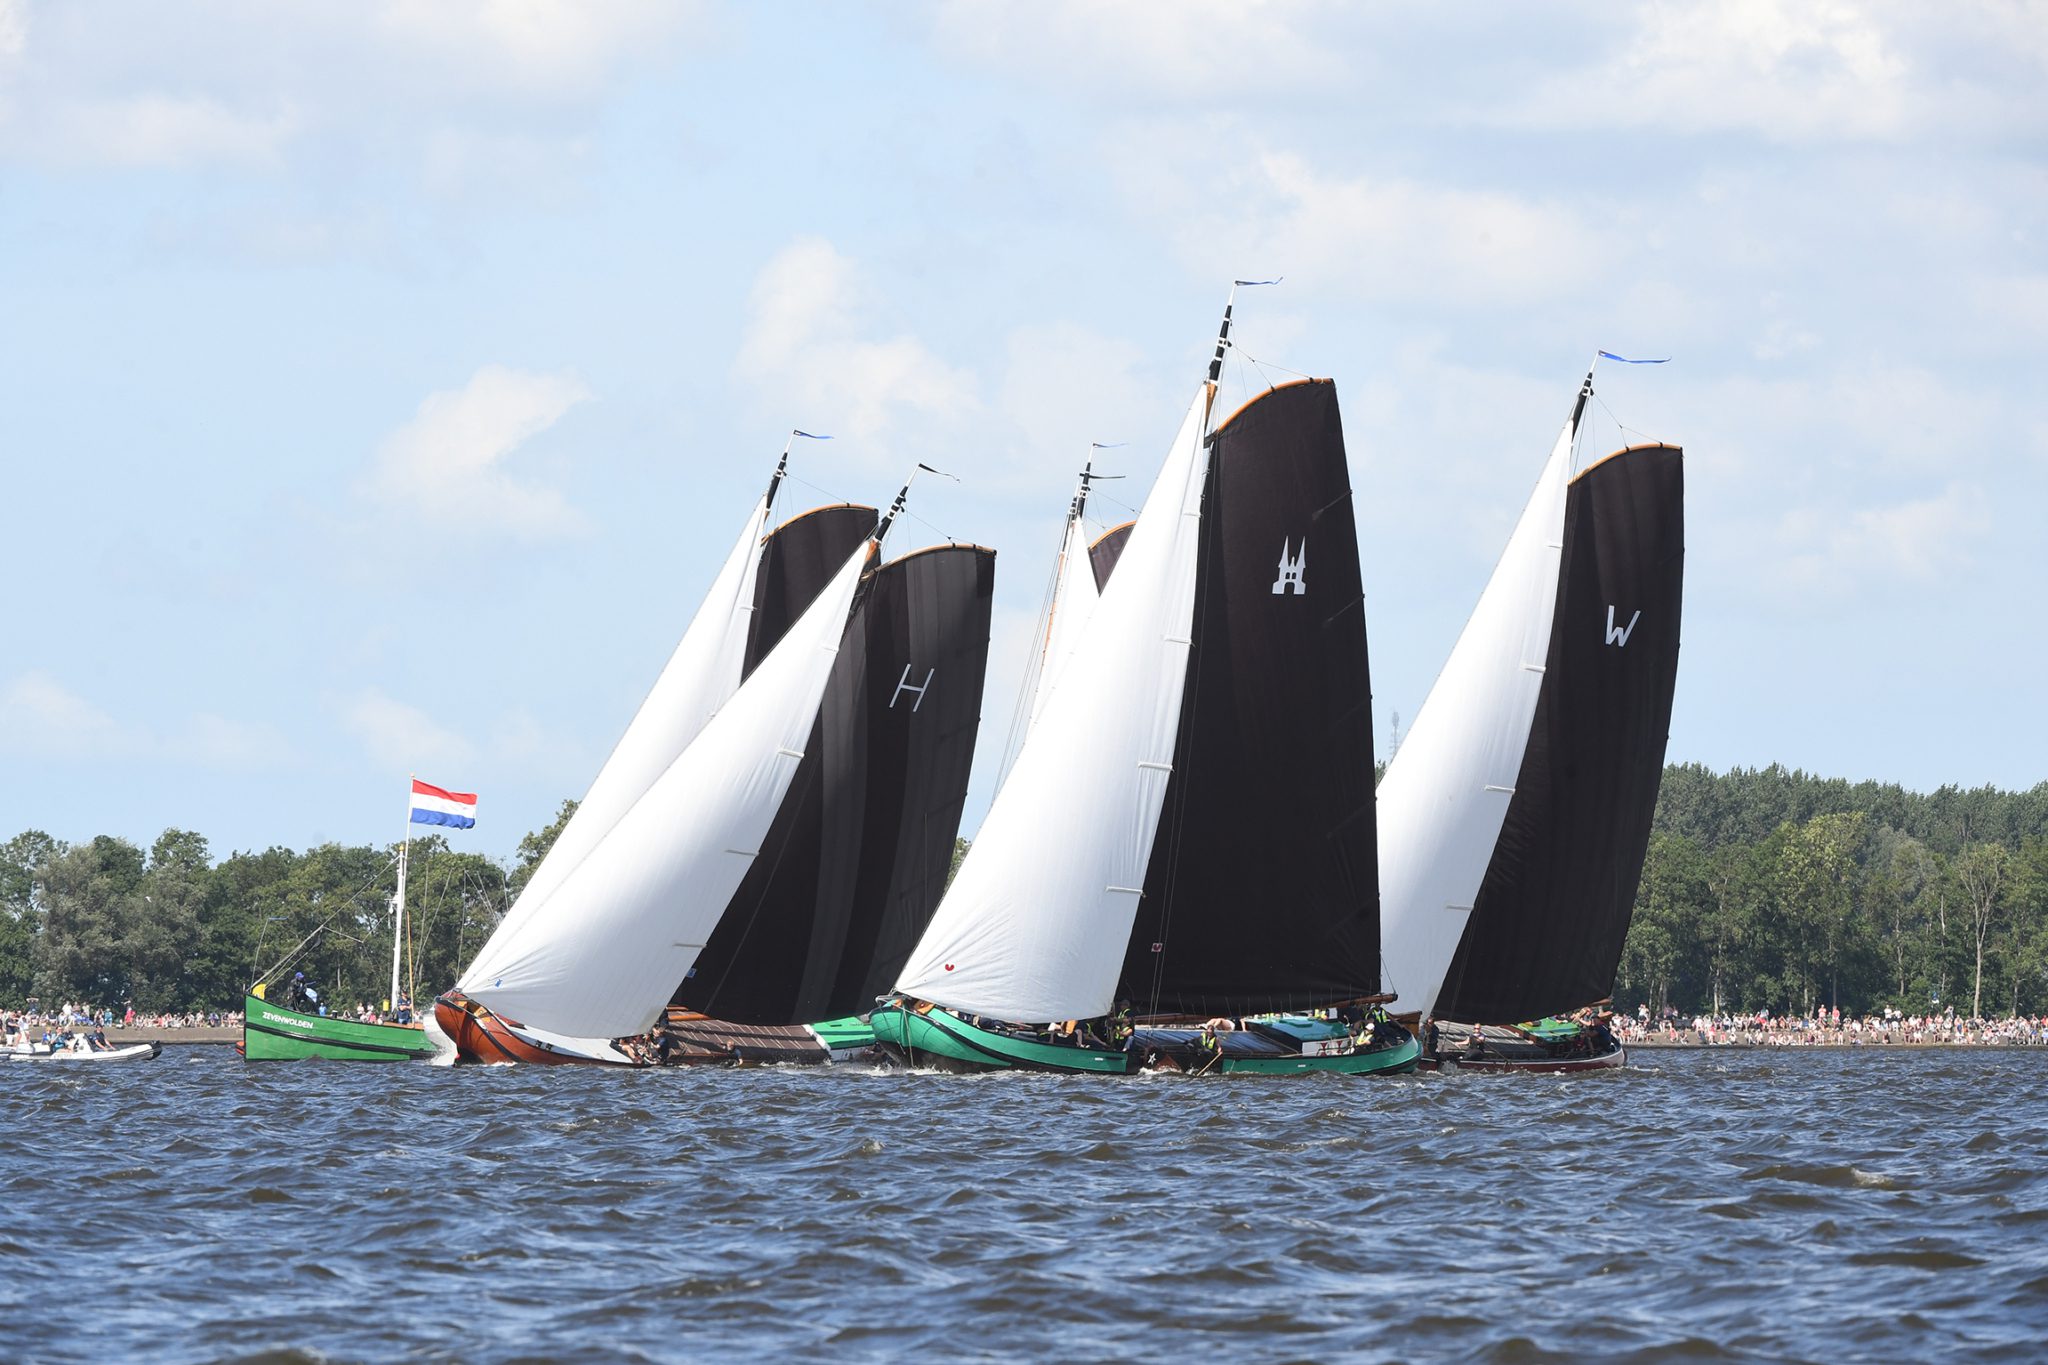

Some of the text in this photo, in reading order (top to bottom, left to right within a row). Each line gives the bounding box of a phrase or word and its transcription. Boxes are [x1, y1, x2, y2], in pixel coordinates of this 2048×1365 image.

[1605, 604, 1641, 647] W
[889, 664, 935, 712] H
[262, 1011, 314, 1029] ZEVENWOLDEN
